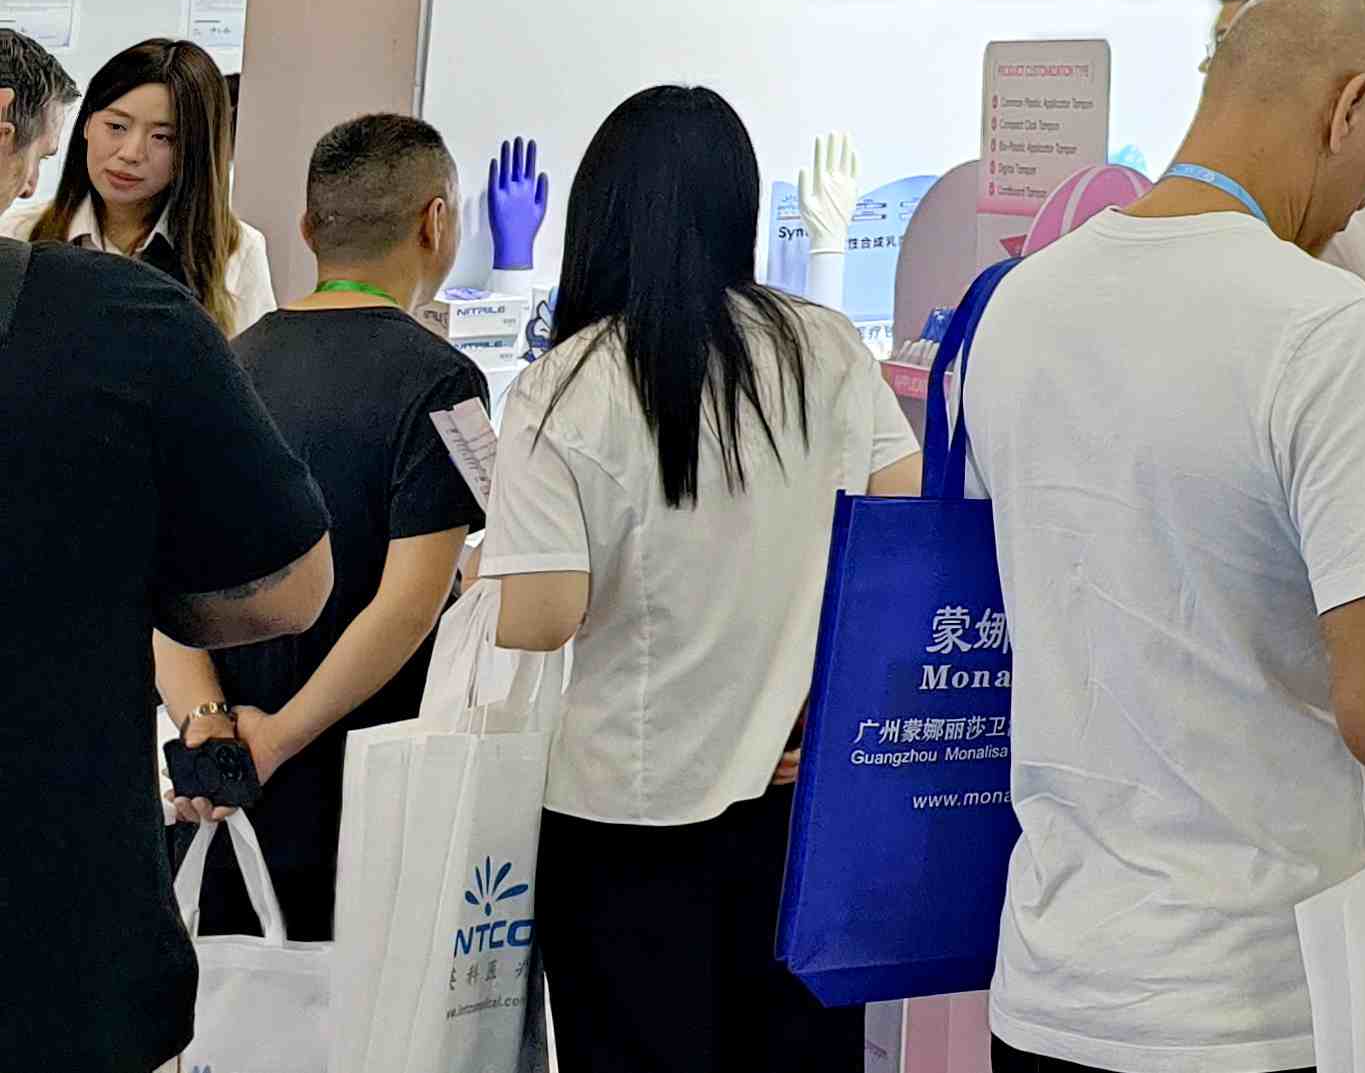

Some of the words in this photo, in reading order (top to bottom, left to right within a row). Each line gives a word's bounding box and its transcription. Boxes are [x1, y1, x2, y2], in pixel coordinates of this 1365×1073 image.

[848, 235, 900, 250] 性合成乳
[926, 605, 1011, 655] 蒙娜
[853, 716, 1012, 744] 广州蒙娜丽莎卫
[850, 749, 938, 767] Guangzhou
[944, 743, 1008, 763] Monalisa
